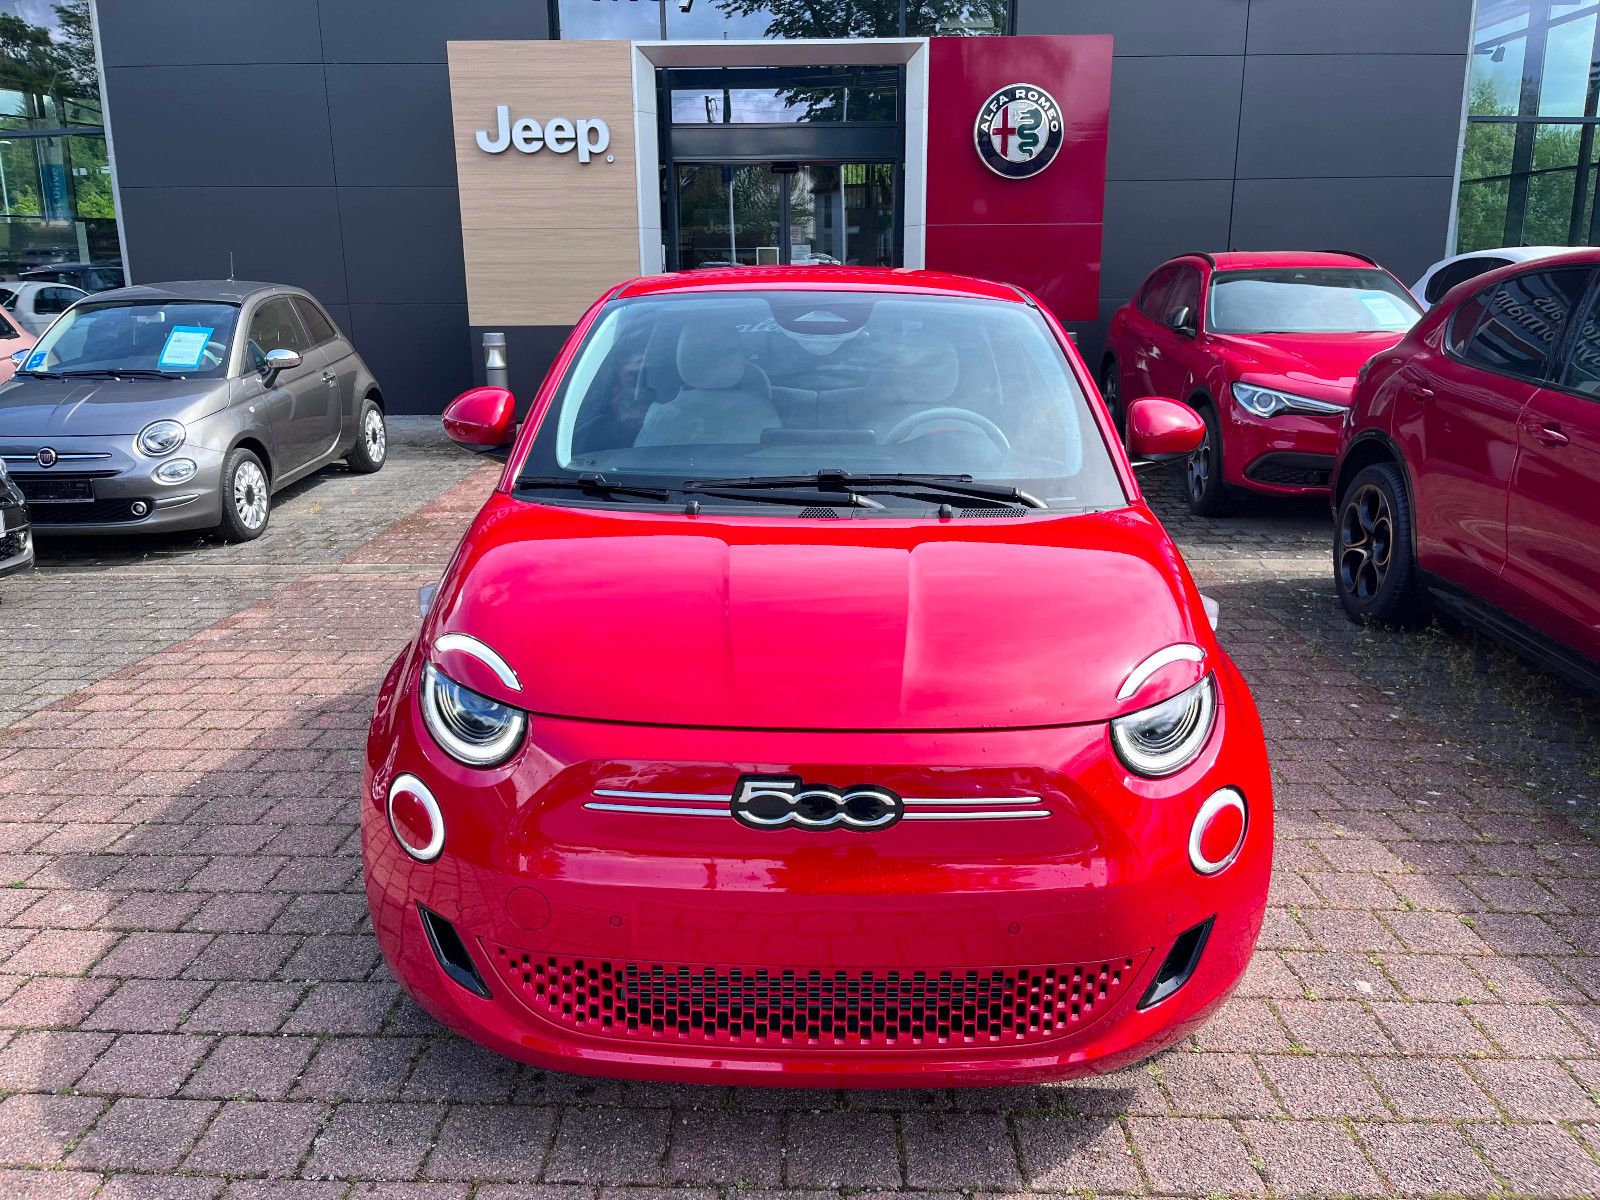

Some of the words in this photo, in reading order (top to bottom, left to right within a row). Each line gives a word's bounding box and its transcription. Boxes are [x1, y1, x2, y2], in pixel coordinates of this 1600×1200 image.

[980, 94, 1009, 132] ALFA
[1015, 89, 1059, 132] ROMEO
[475, 104, 611, 163] Jeep
[738, 781, 895, 826] 500
